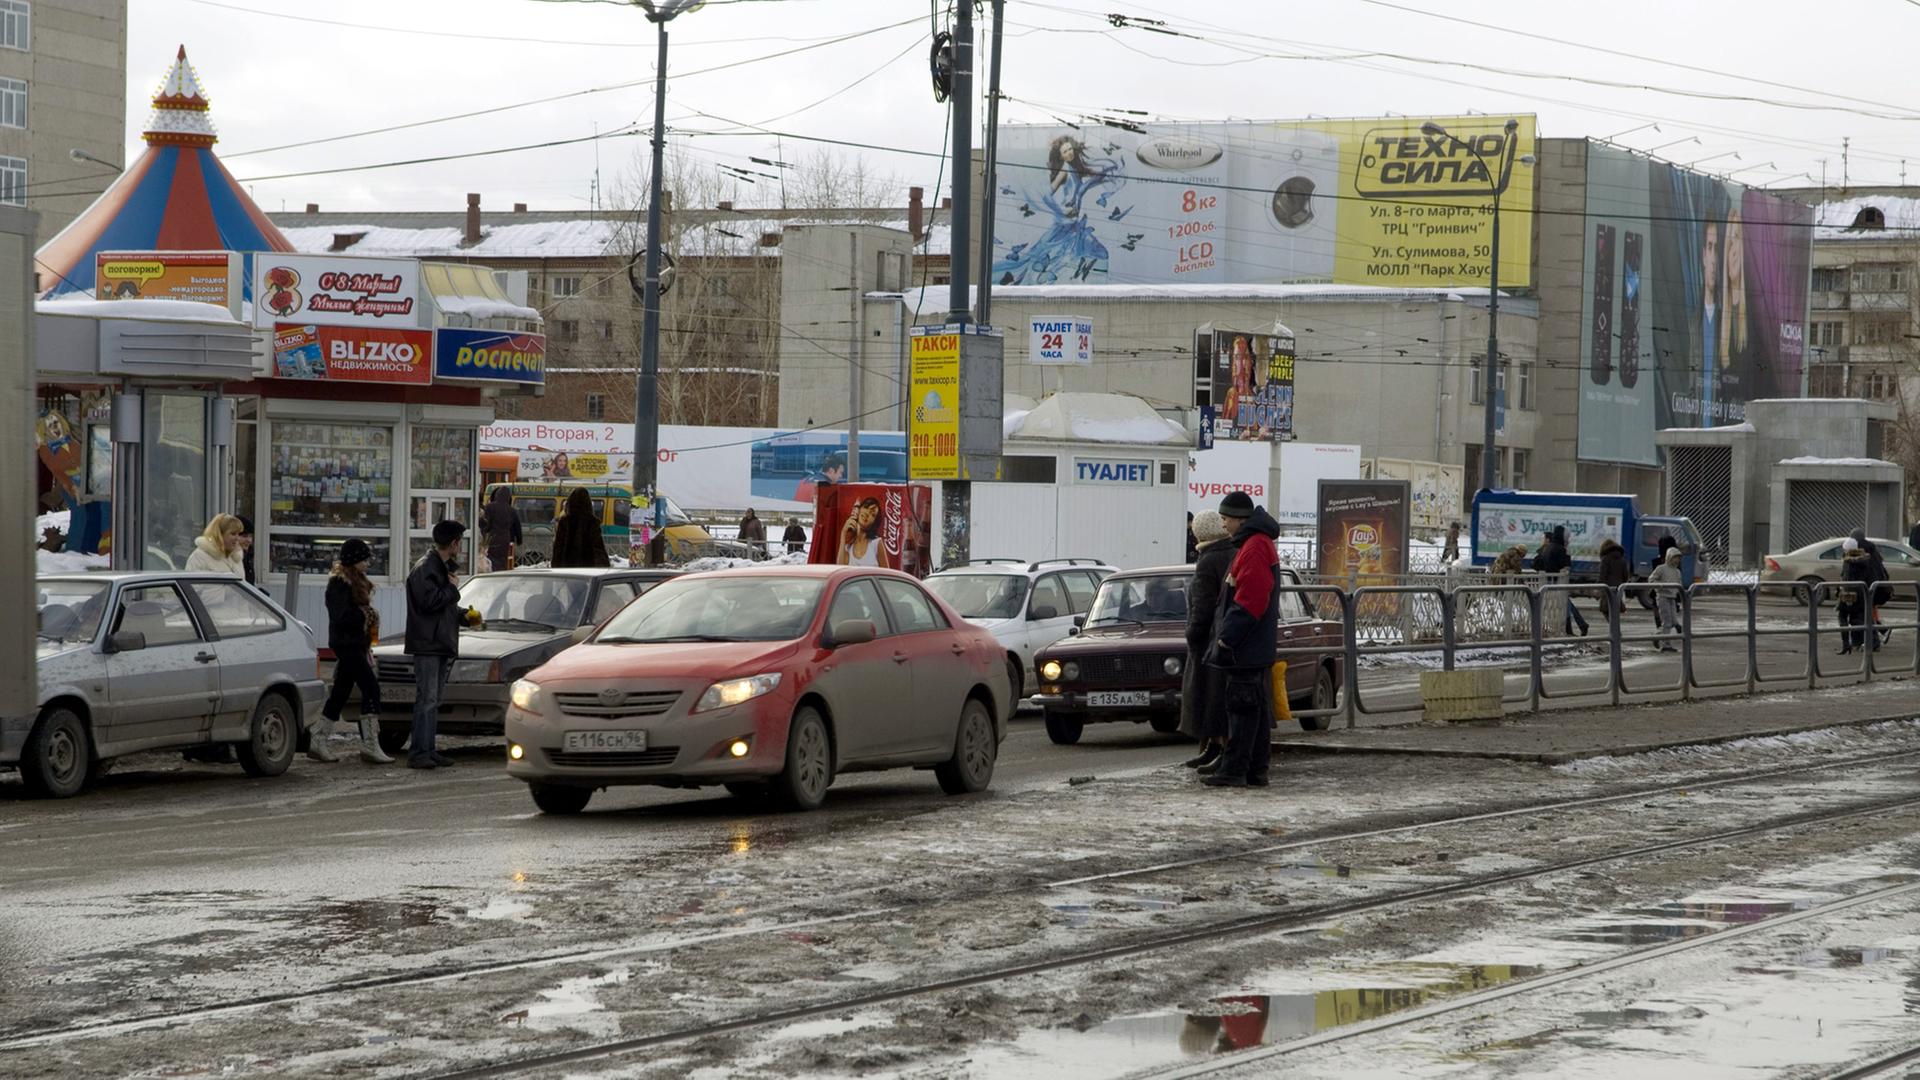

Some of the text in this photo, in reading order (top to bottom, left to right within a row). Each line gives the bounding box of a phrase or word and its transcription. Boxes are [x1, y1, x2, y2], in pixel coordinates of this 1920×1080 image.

[1157, 148, 1203, 160] Whirlpool
[1375, 134, 1504, 159] ТЕХНО
[1380, 160, 1489, 184] СИЛА
[1183, 190, 1217, 213] 8 кг
[1370, 206, 1391, 218] Ул.
[1394, 205, 1424, 217] 8-го
[1428, 206, 1474, 219] марта,
[1168, 221, 1217, 239] 1200 об.
[1382, 223, 1409, 236] ТРЦ
[1180, 242, 1213, 262] LCD
[1372, 246, 1393, 258] Ул.
[1397, 246, 1470, 261] Сулимова,
[108, 264, 160, 276] поговорим!
[1174, 258, 1216, 274] дисплей
[1367, 263, 1410, 276] МОЛЛ
[319, 271, 402, 297] С 8 Марта!
[310, 295, 413, 317] Милые женщины!
[1033, 323, 1073, 332] ТУАЛЕТ
[1780, 323, 1802, 341] NOKIA
[914, 336, 958, 352] ТАКСИ
[1042, 334, 1064, 349] 24
[1078, 335, 1089, 350] 24
[331, 340, 415, 363] BLiZKO
[1041, 351, 1063, 359] ЧАСА
[331, 361, 413, 373] НЕДВИЖИМОСТЬ
[1274, 354, 1294, 367] DEEP
[1269, 367, 1293, 380] PURPLE
[1237, 403, 1292, 429] HUGHES
[537, 425, 600, 444] Вторая,
[605, 427, 615, 441] 2
[913, 433, 956, 457] 310-1000
[521, 462, 540, 471] 19:30
[1077, 463, 1148, 481] ТУАЛЕТ
[1189, 482, 1264, 498] чувства
